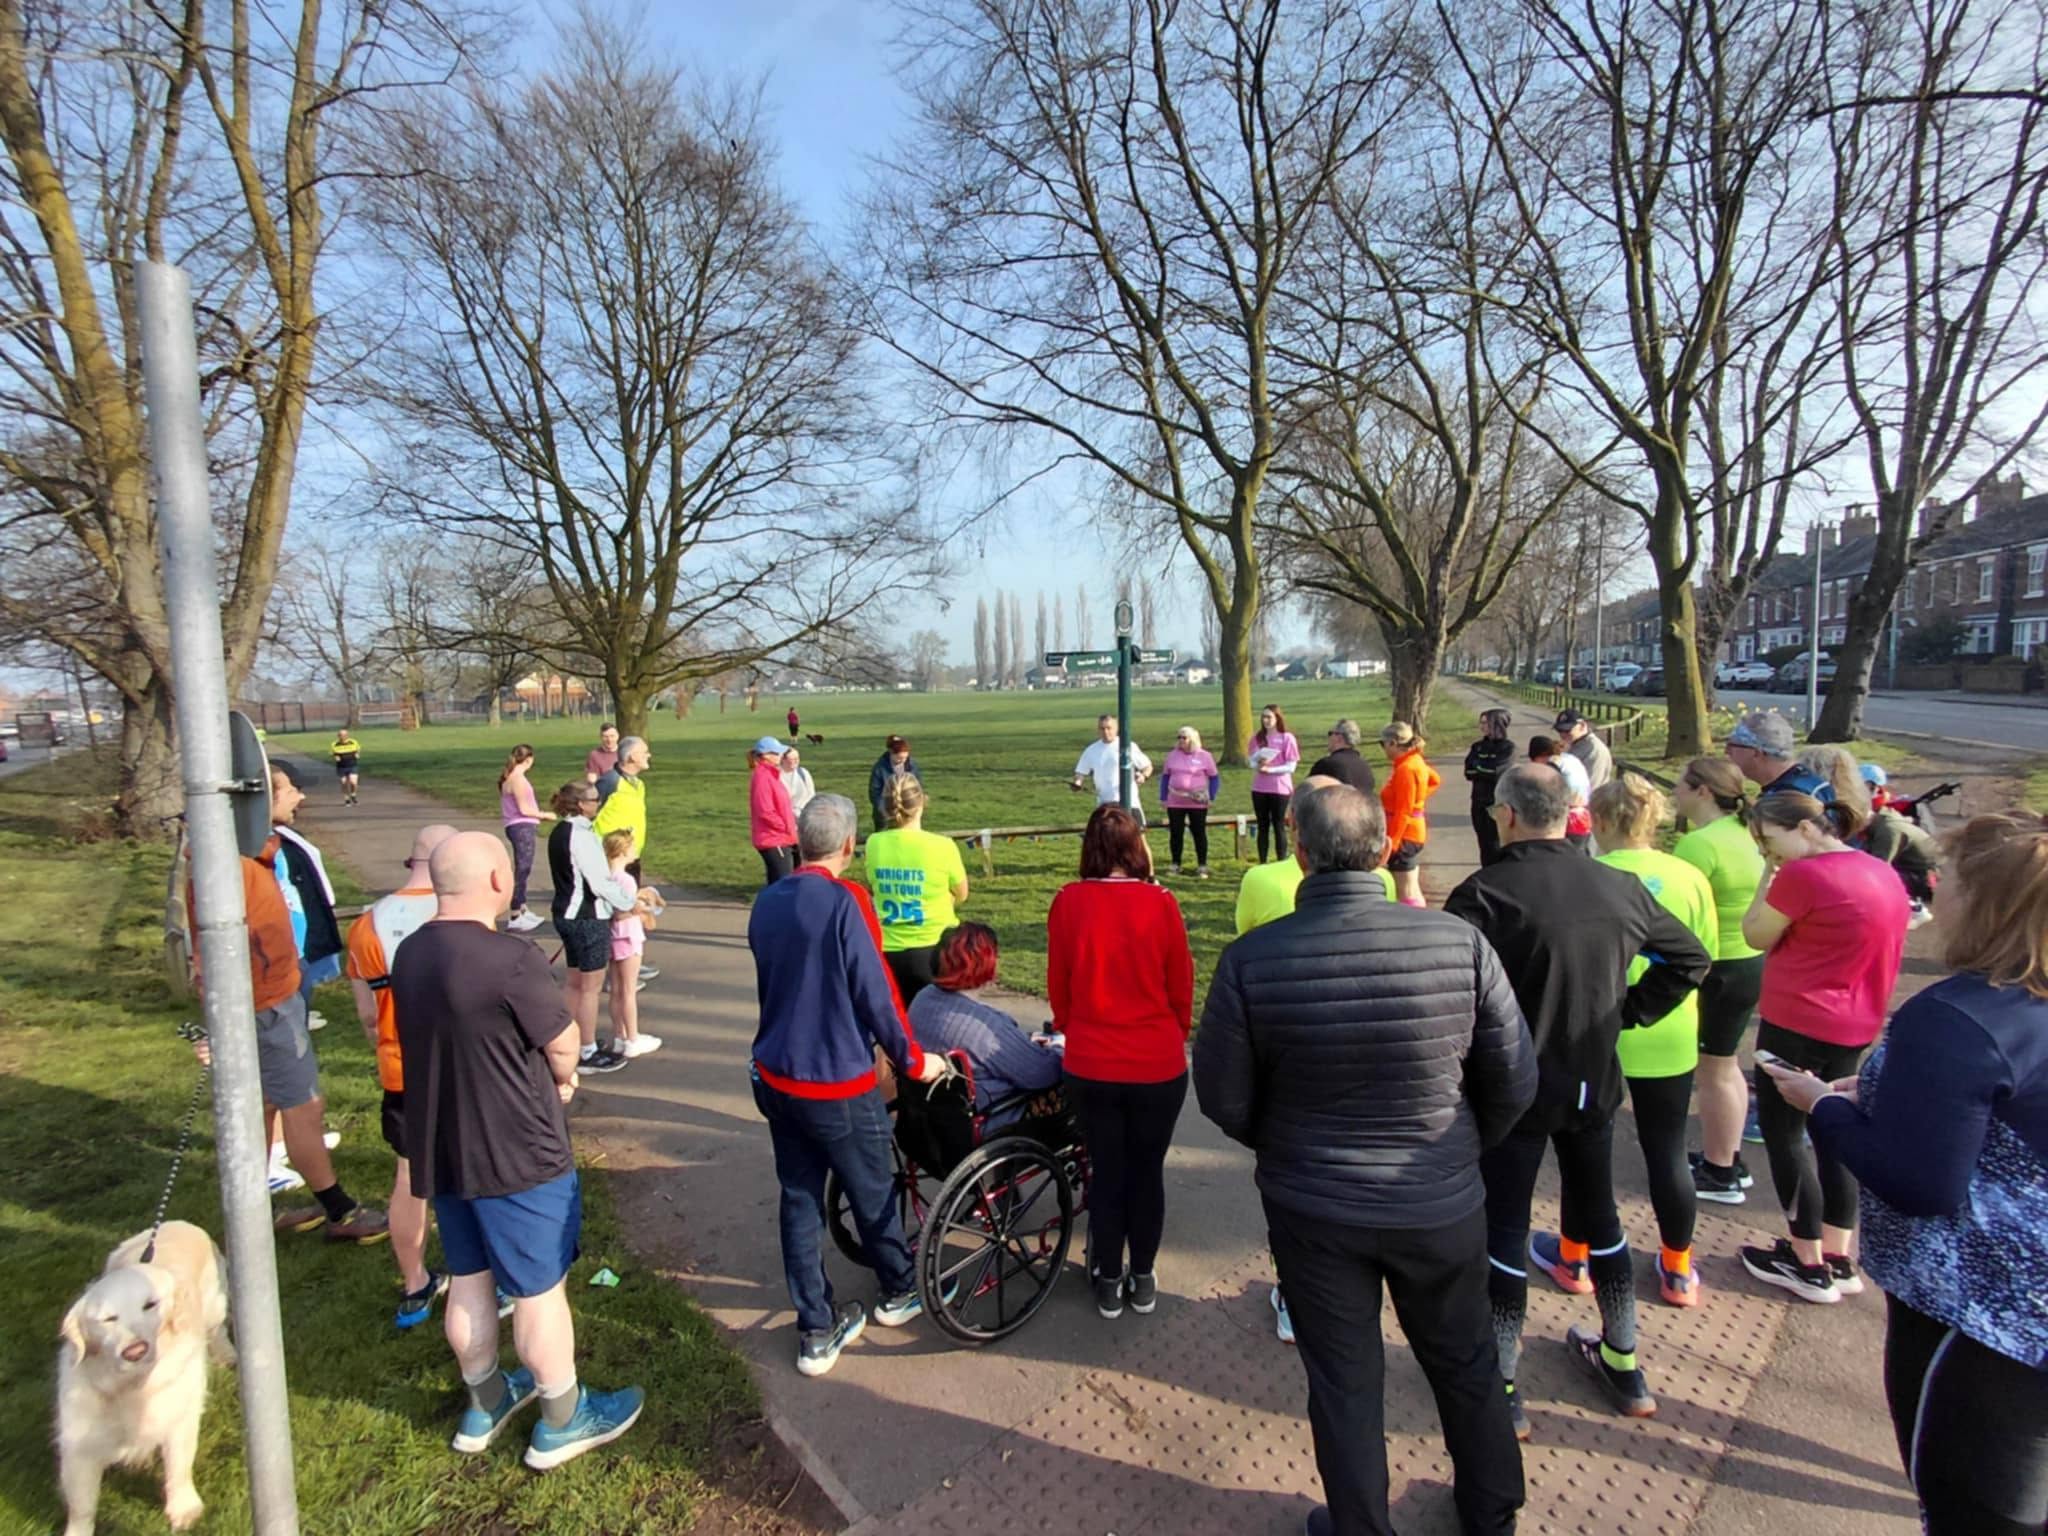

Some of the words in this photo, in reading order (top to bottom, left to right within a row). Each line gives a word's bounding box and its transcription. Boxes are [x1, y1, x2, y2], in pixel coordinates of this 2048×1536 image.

[875, 867, 924, 881] WRIGHTS
[879, 883, 892, 894] ON
[895, 883, 922, 896] TOUR
[882, 899, 924, 926] 25
